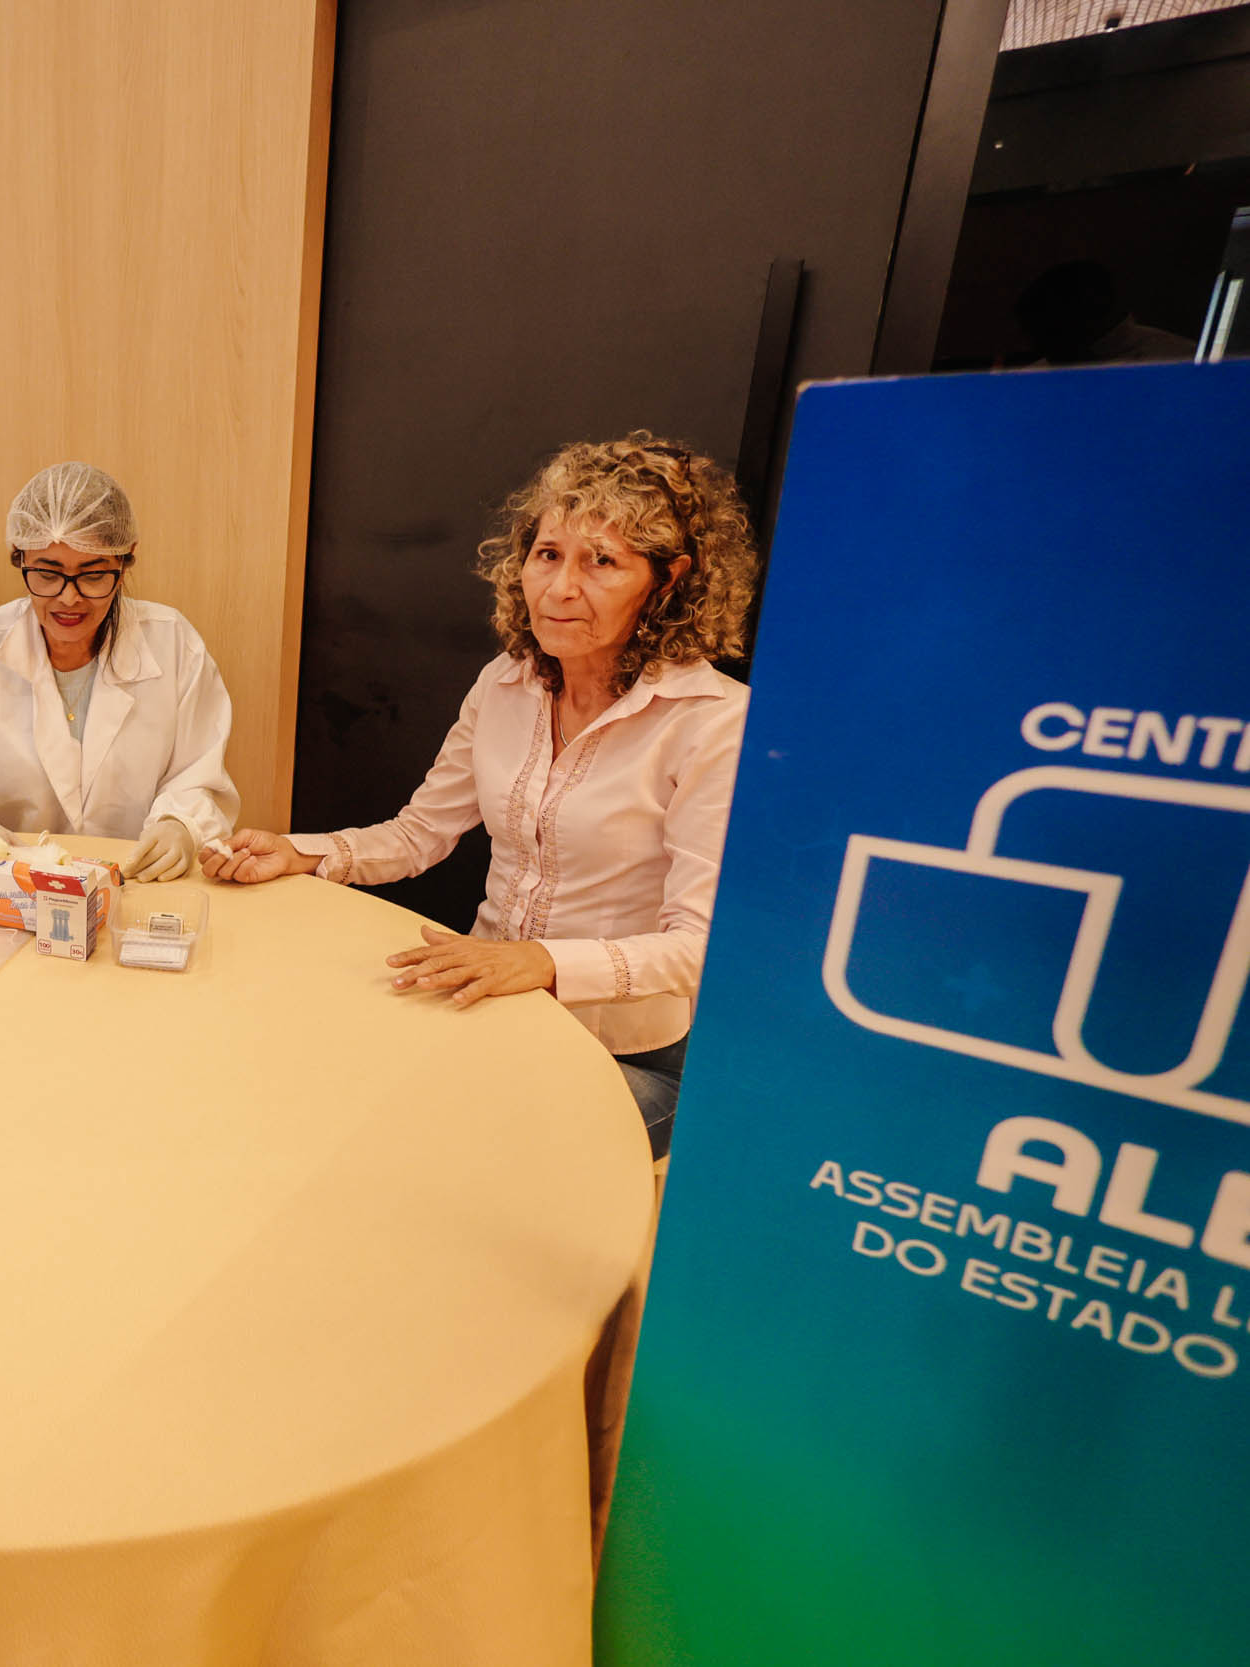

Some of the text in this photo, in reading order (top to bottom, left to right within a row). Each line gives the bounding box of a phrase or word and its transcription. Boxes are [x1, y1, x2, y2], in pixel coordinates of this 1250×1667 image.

[1020, 701, 1250, 772] CENT
[810, 1160, 1250, 1333] ASSEMBLEIA L
[852, 1220, 1238, 1378] DO ESTADO
